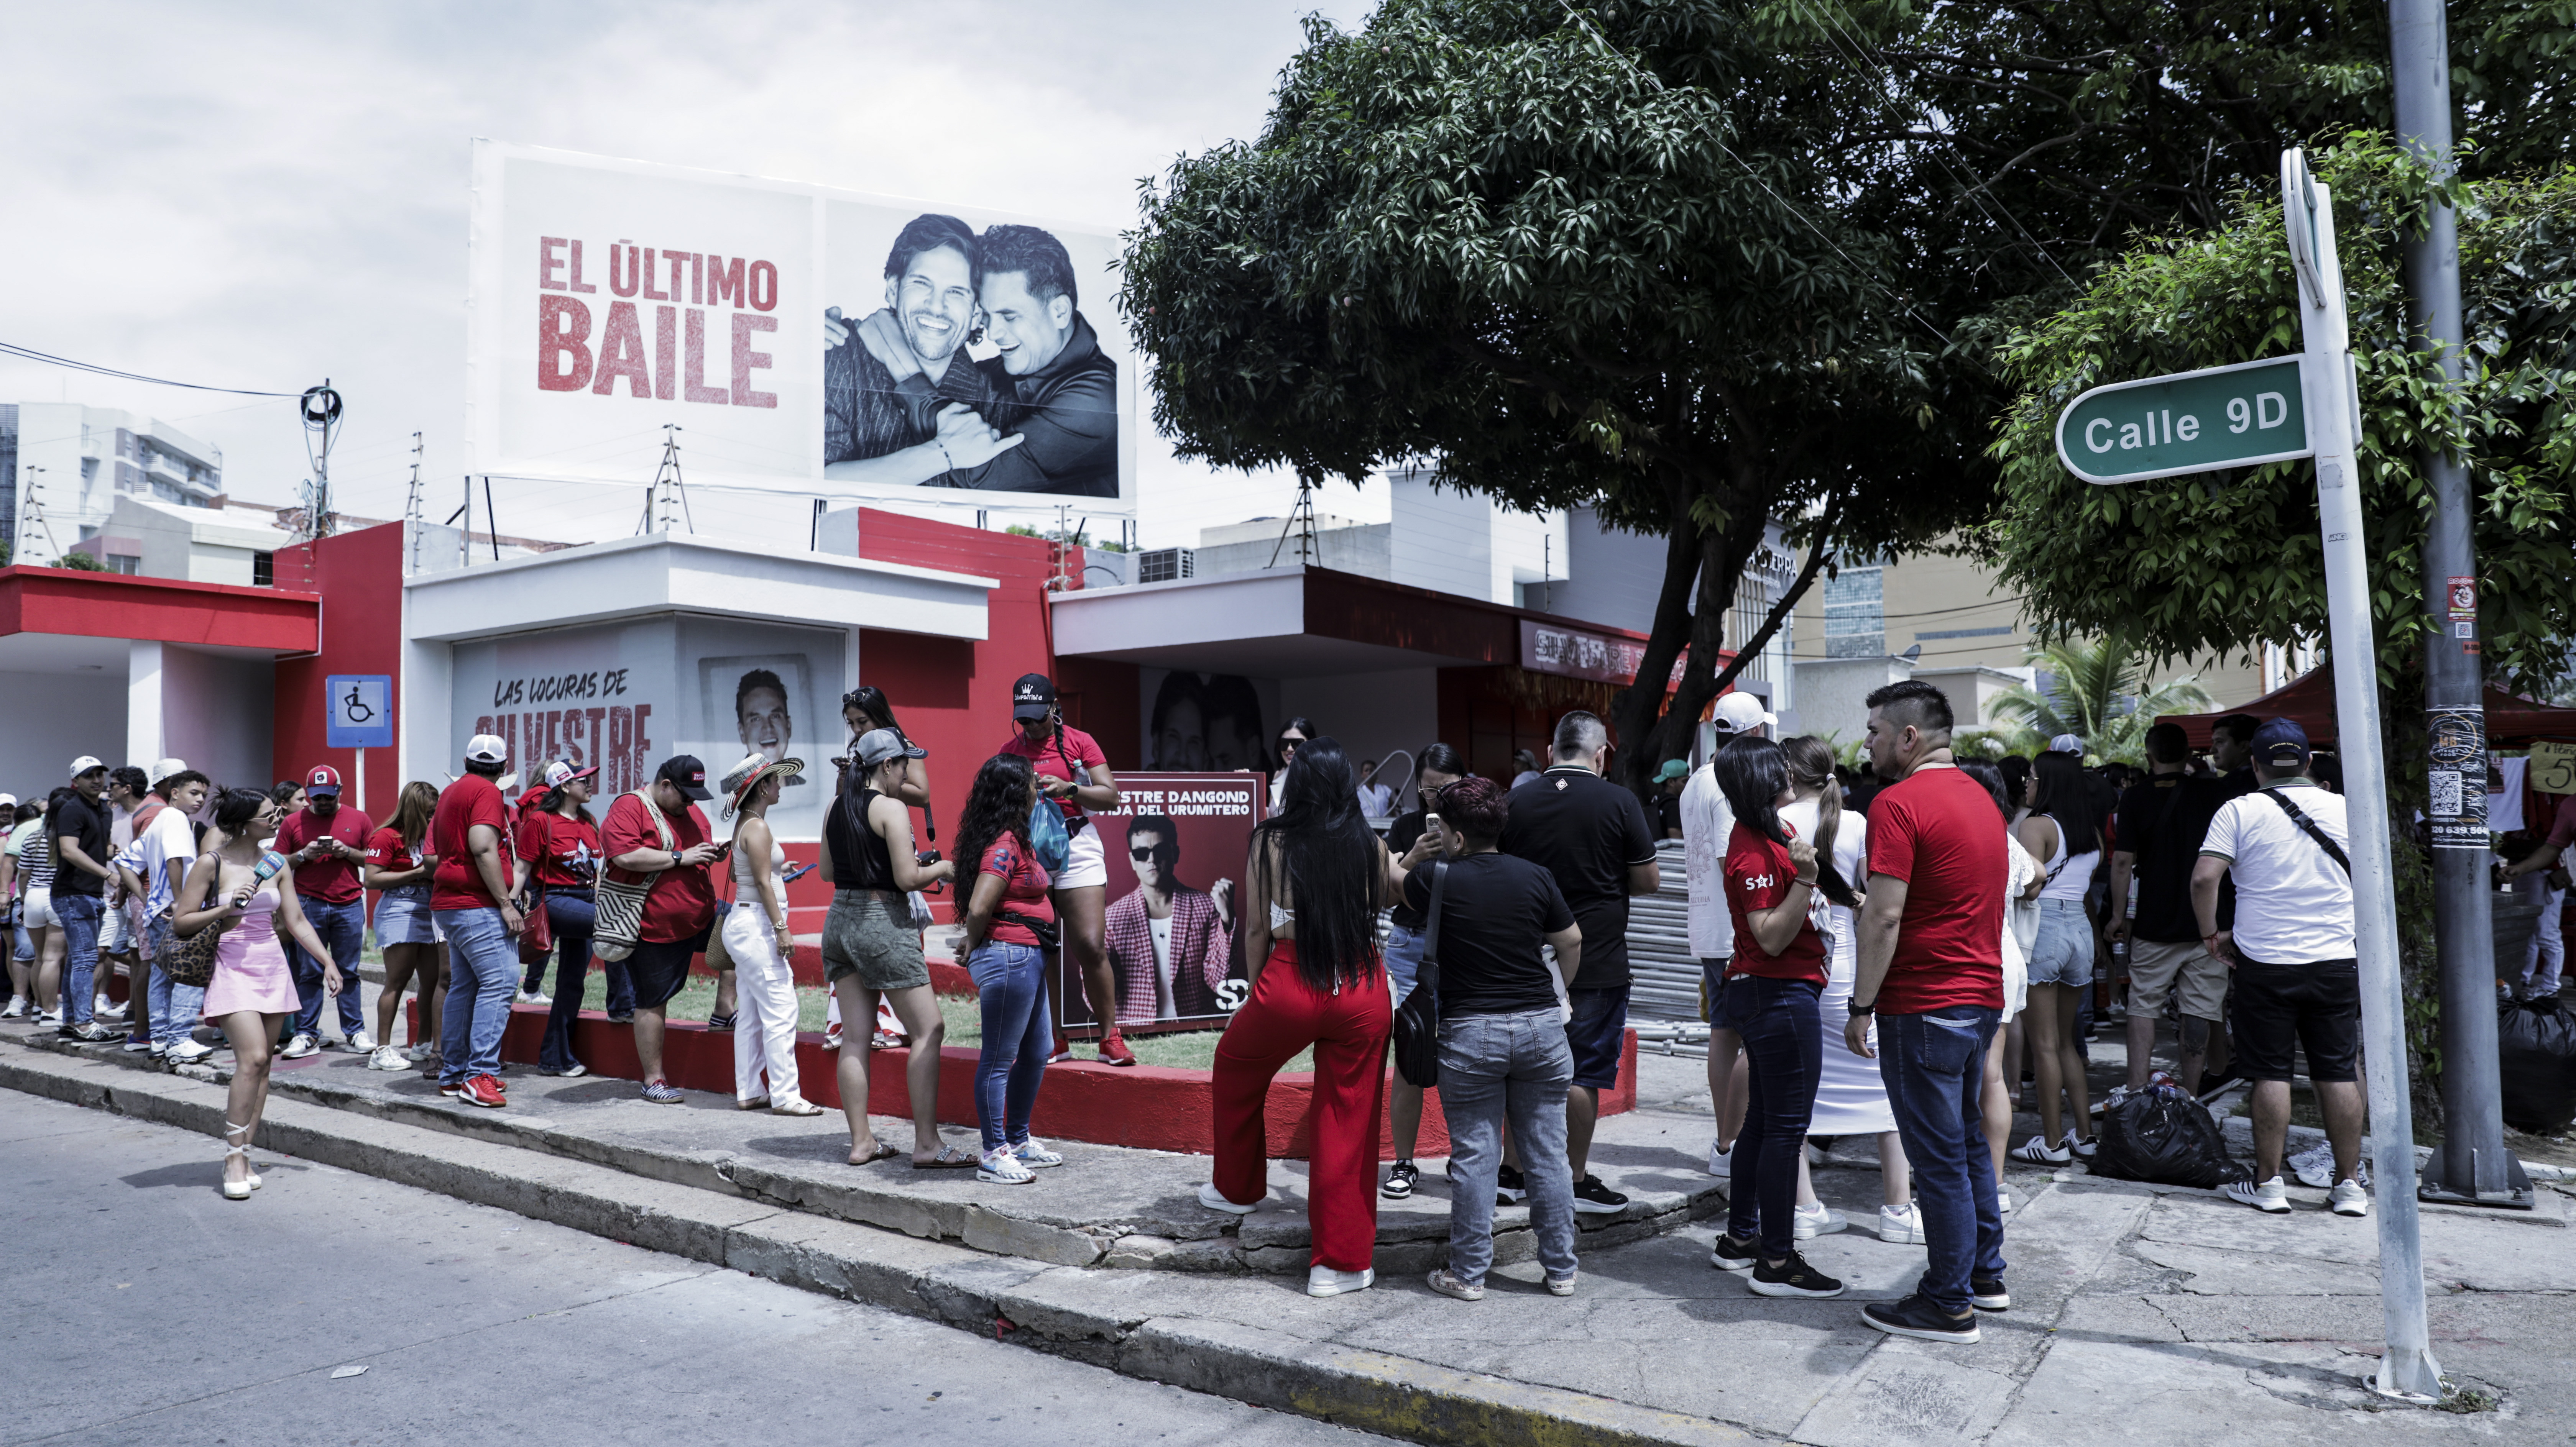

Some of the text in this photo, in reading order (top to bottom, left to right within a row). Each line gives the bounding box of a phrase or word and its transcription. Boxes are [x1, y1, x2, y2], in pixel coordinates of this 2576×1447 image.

[540, 236, 778, 312] EL ÚLTIMO
[538, 294, 778, 409] BAILE
[2085, 391, 2287, 453] Calle 9D
[494, 668, 629, 708] LAS LOCURAS DE
[1119, 791, 1250, 804] STRE DANGOND
[1137, 805, 1165, 816] DEL
[1168, 804, 1250, 815] URUMITERO
